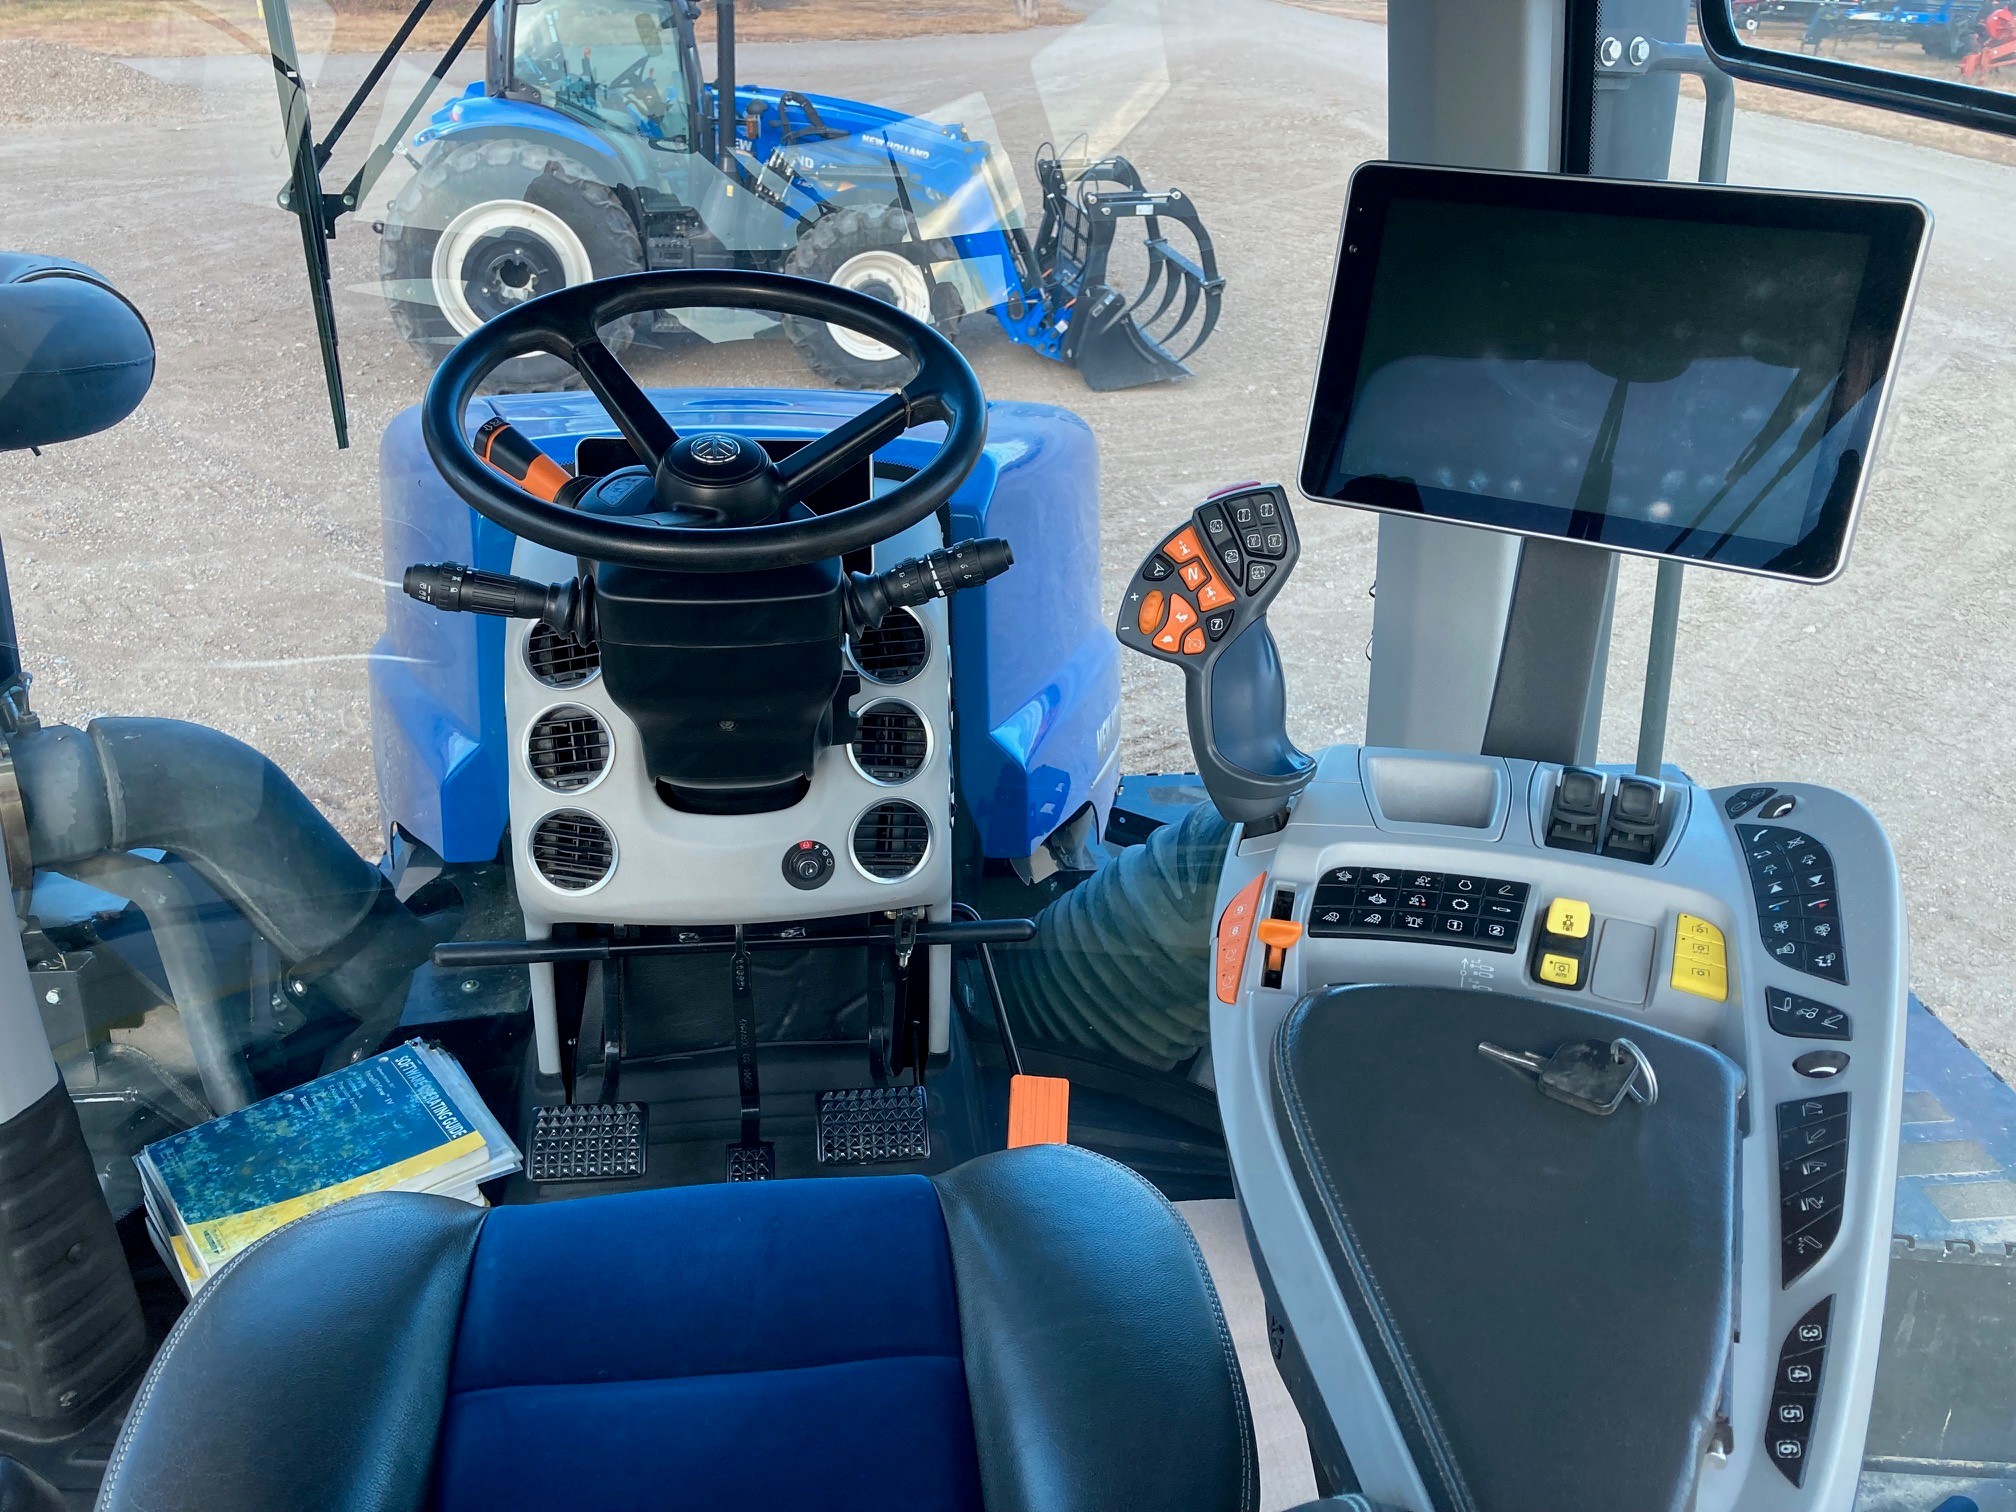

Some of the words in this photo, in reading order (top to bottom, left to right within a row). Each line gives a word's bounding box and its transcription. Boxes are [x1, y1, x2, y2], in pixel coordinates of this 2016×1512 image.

[735, 138, 752, 152] EW
[861, 134, 884, 147] NEW
[887, 141, 930, 159] HOLLAND
[1187, 567, 1199, 581] N
[395, 1055, 429, 1087] SOFTWARE
[417, 1084, 453, 1120] OPERATING
[442, 1117, 467, 1138] GUIDE
[1802, 1328, 1819, 1338] 3
[1792, 1369, 1809, 1379] 4
[1783, 1409, 1800, 1419] 5
[1780, 1444, 1798, 1455] 6
